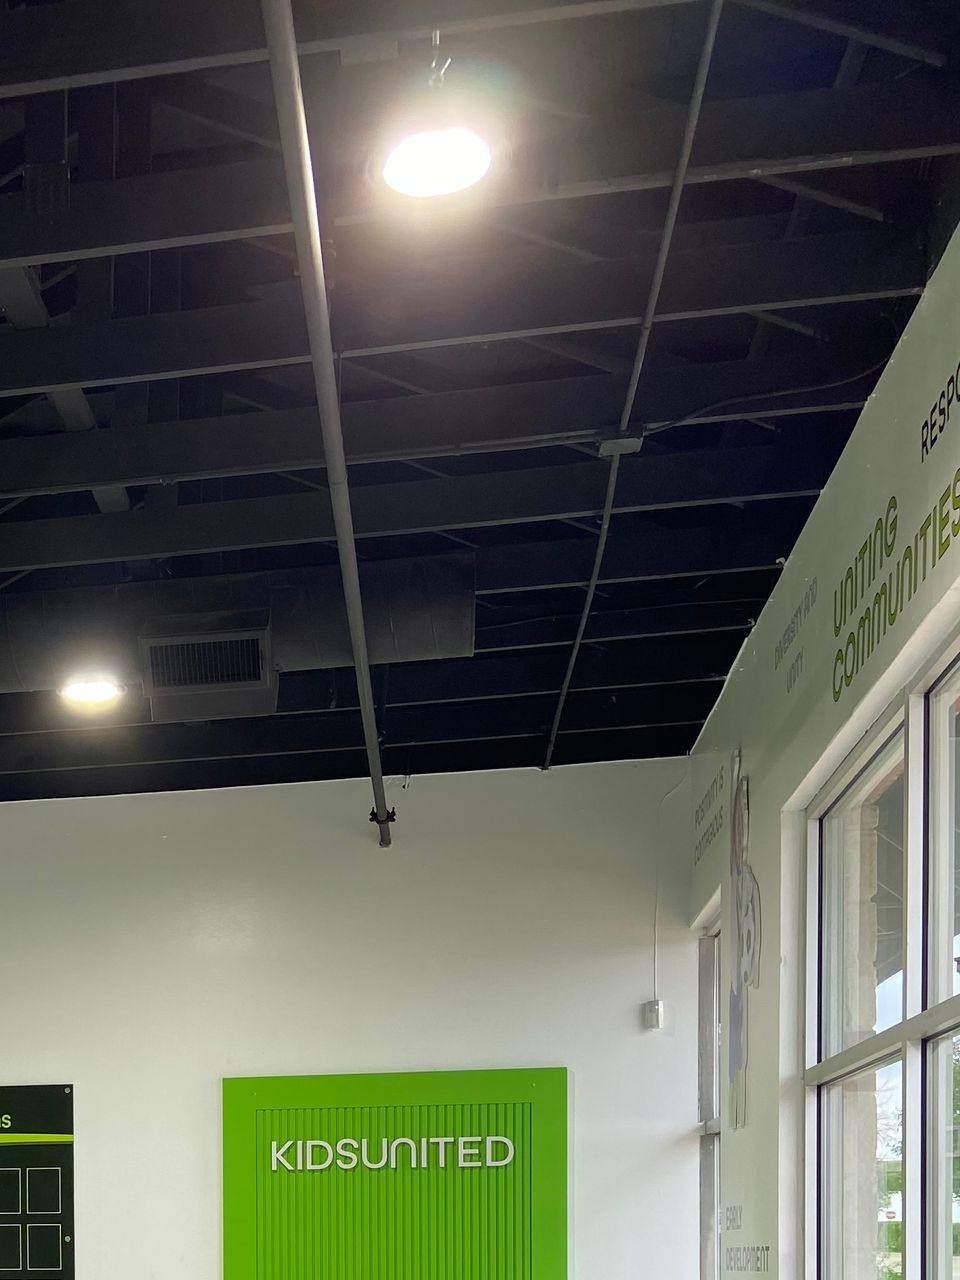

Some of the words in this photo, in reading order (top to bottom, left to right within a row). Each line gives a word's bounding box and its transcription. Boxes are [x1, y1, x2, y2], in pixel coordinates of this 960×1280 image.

[832, 467, 960, 702] COMMUNITIES
[834, 496, 898, 637] UNITING
[271, 1135, 515, 1171] KIDSUNITED
